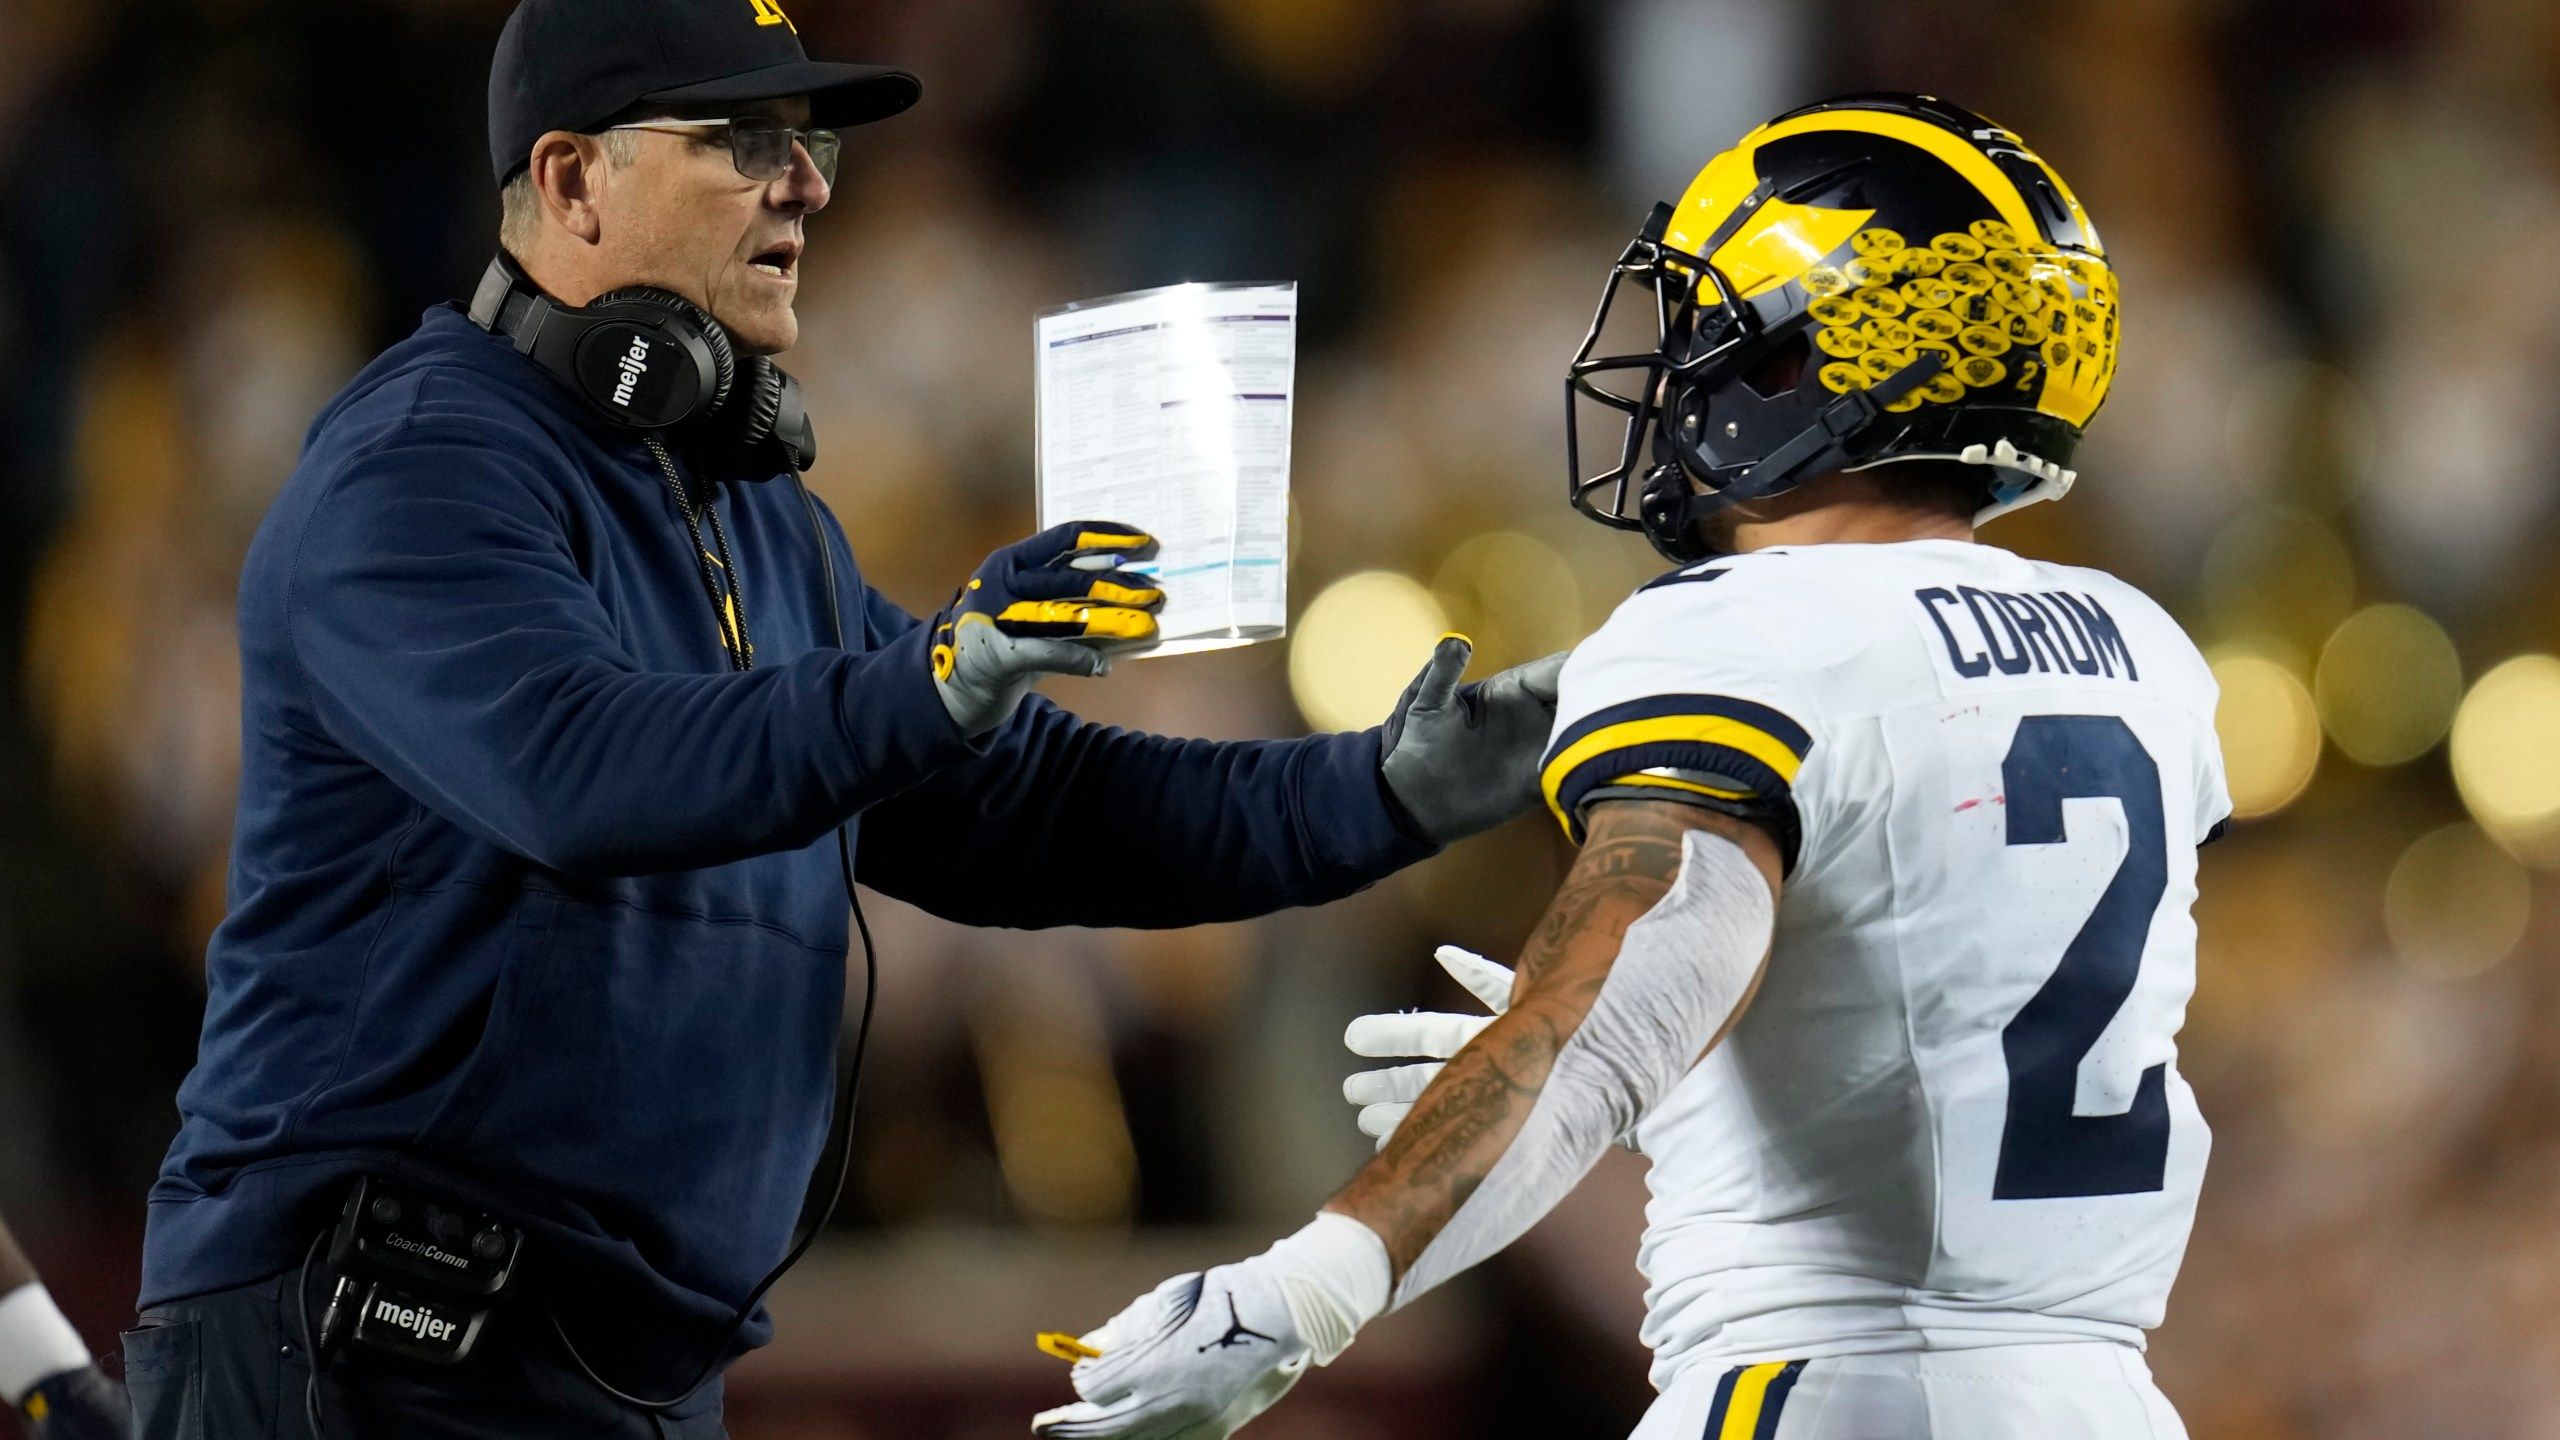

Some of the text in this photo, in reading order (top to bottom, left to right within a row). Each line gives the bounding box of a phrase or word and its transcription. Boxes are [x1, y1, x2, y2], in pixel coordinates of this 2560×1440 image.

[613, 335, 649, 406] meijer
[2016, 360, 2038, 391] 2
[1916, 586, 2138, 682] CORUM
[1992, 714, 2170, 1201] 2
[386, 1232, 469, 1268] CoachComm
[375, 1300, 456, 1341] meijer
